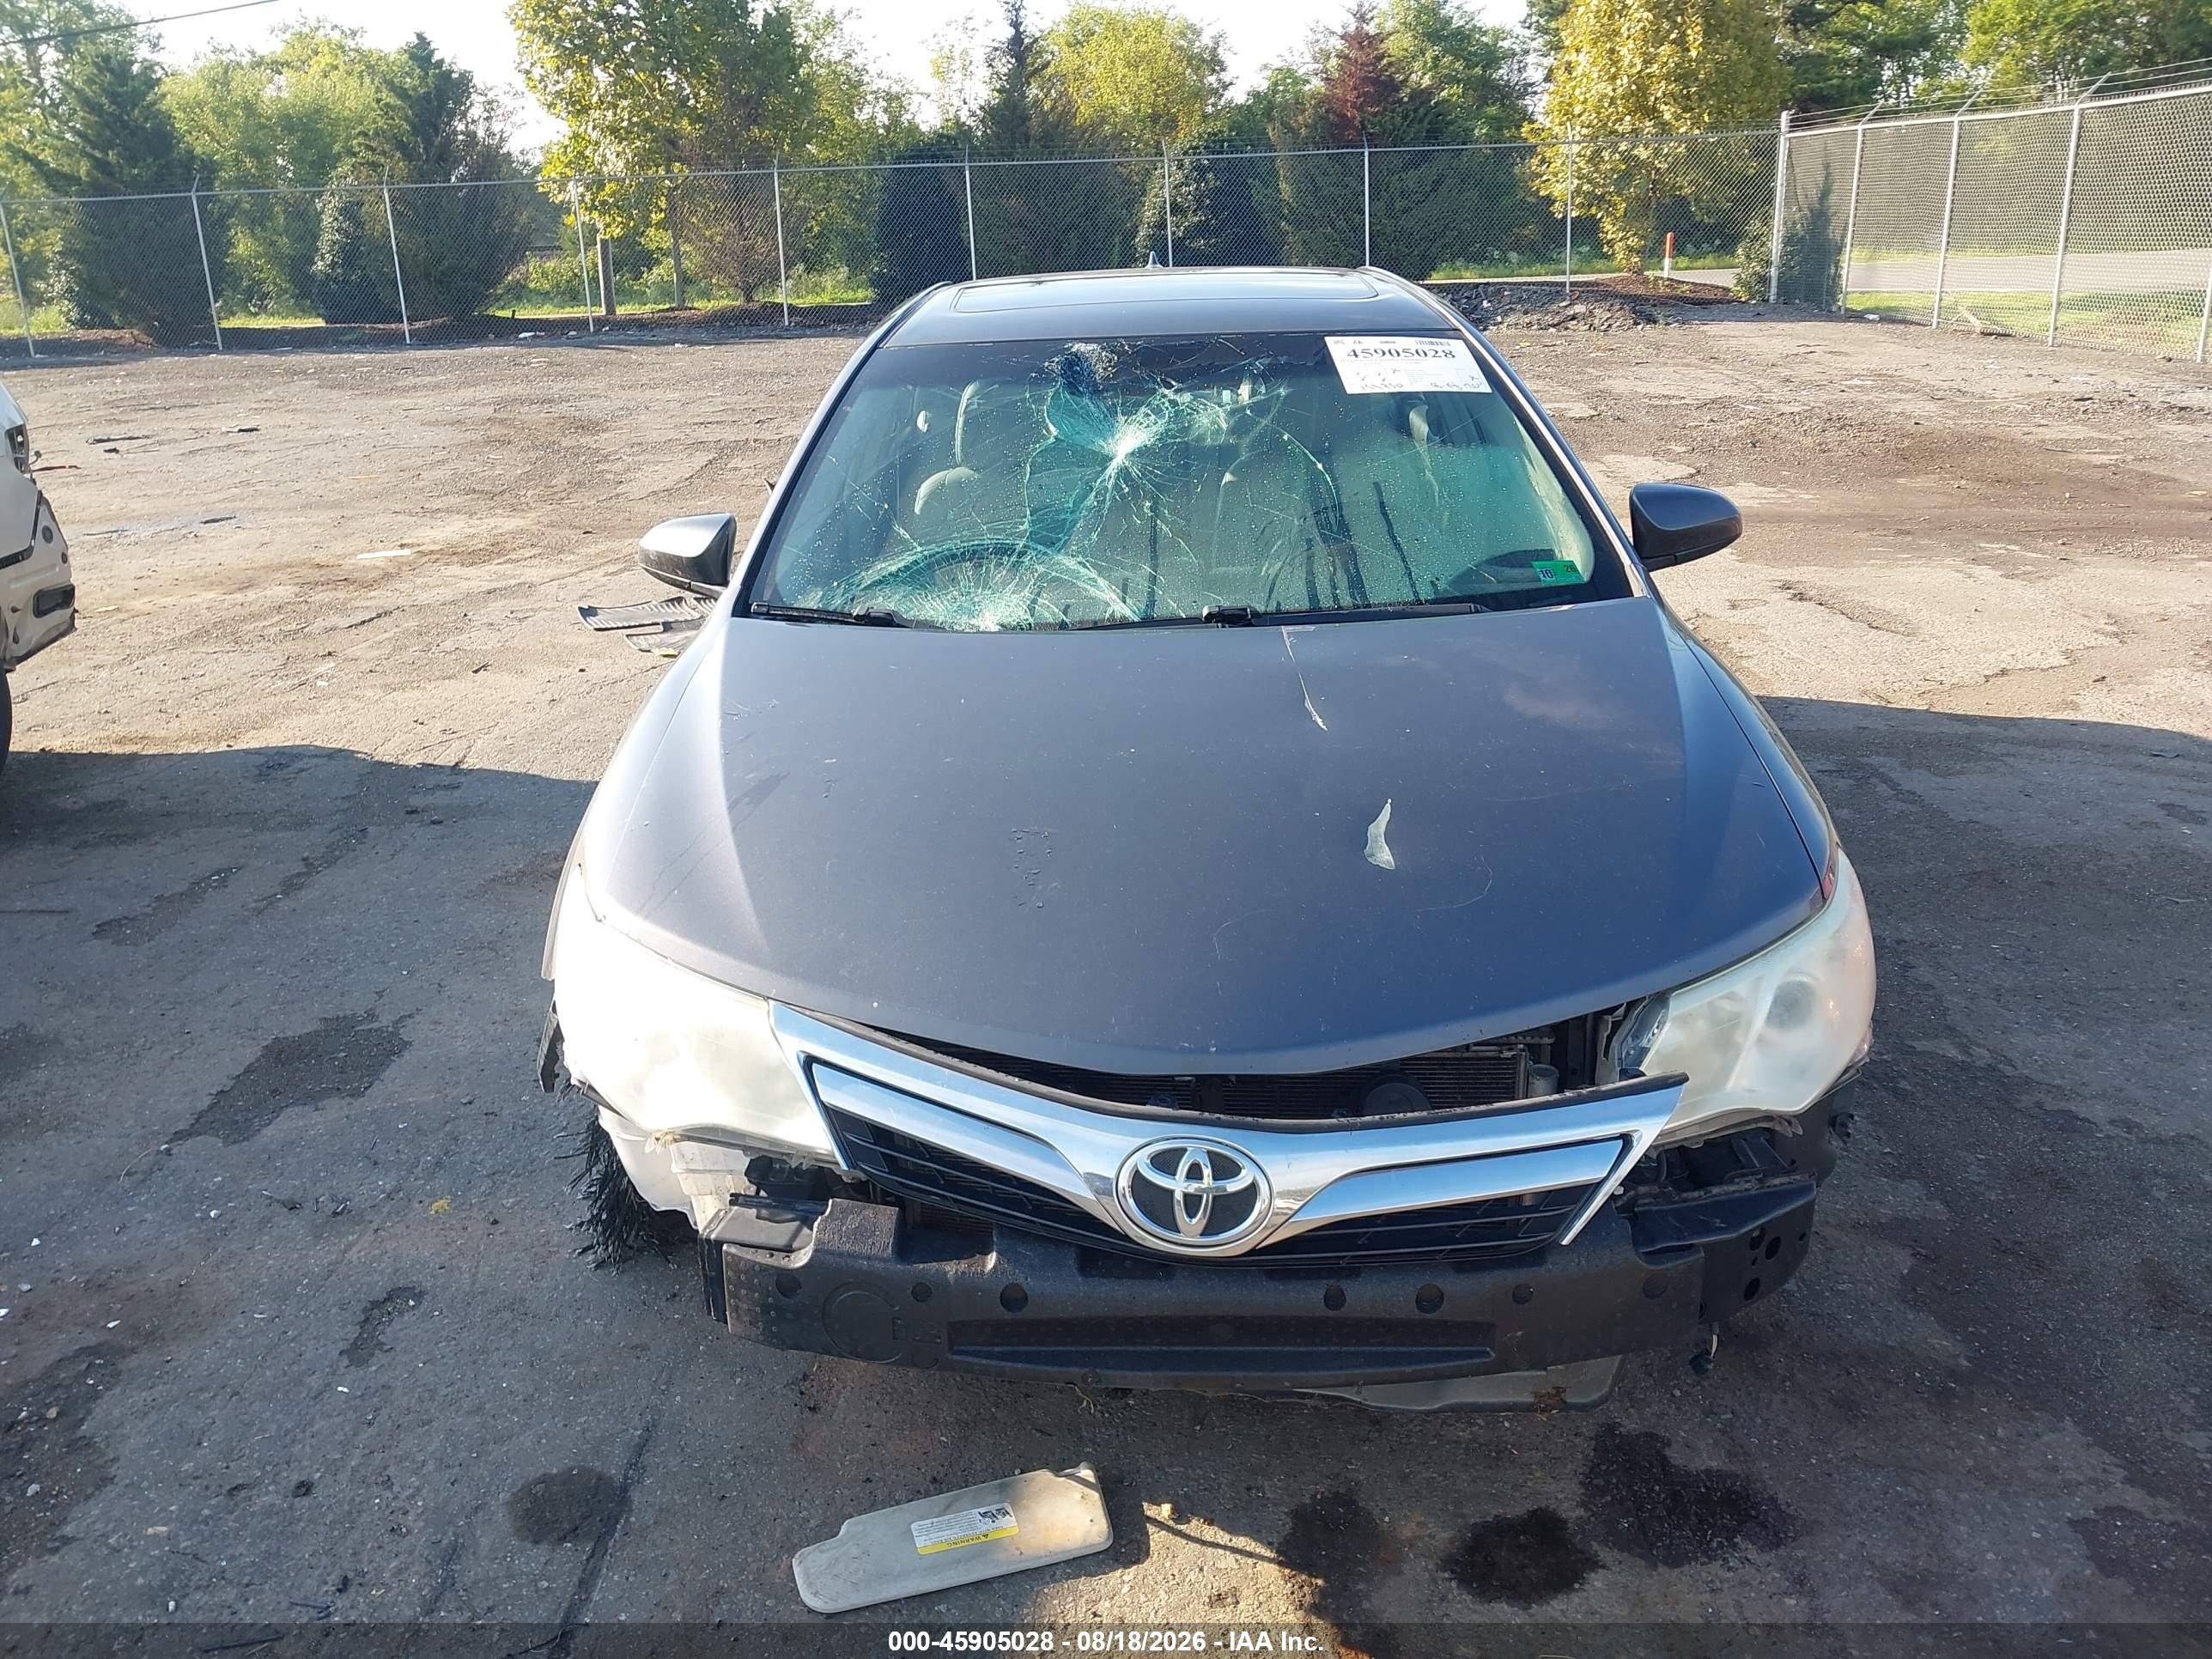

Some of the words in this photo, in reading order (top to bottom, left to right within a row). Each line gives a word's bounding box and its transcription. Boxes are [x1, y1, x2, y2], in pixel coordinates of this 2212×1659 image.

[1346, 347, 1456, 359] 45905028
[1539, 568, 1553, 579] 10
[946, 1535, 982, 1547] WARNING
